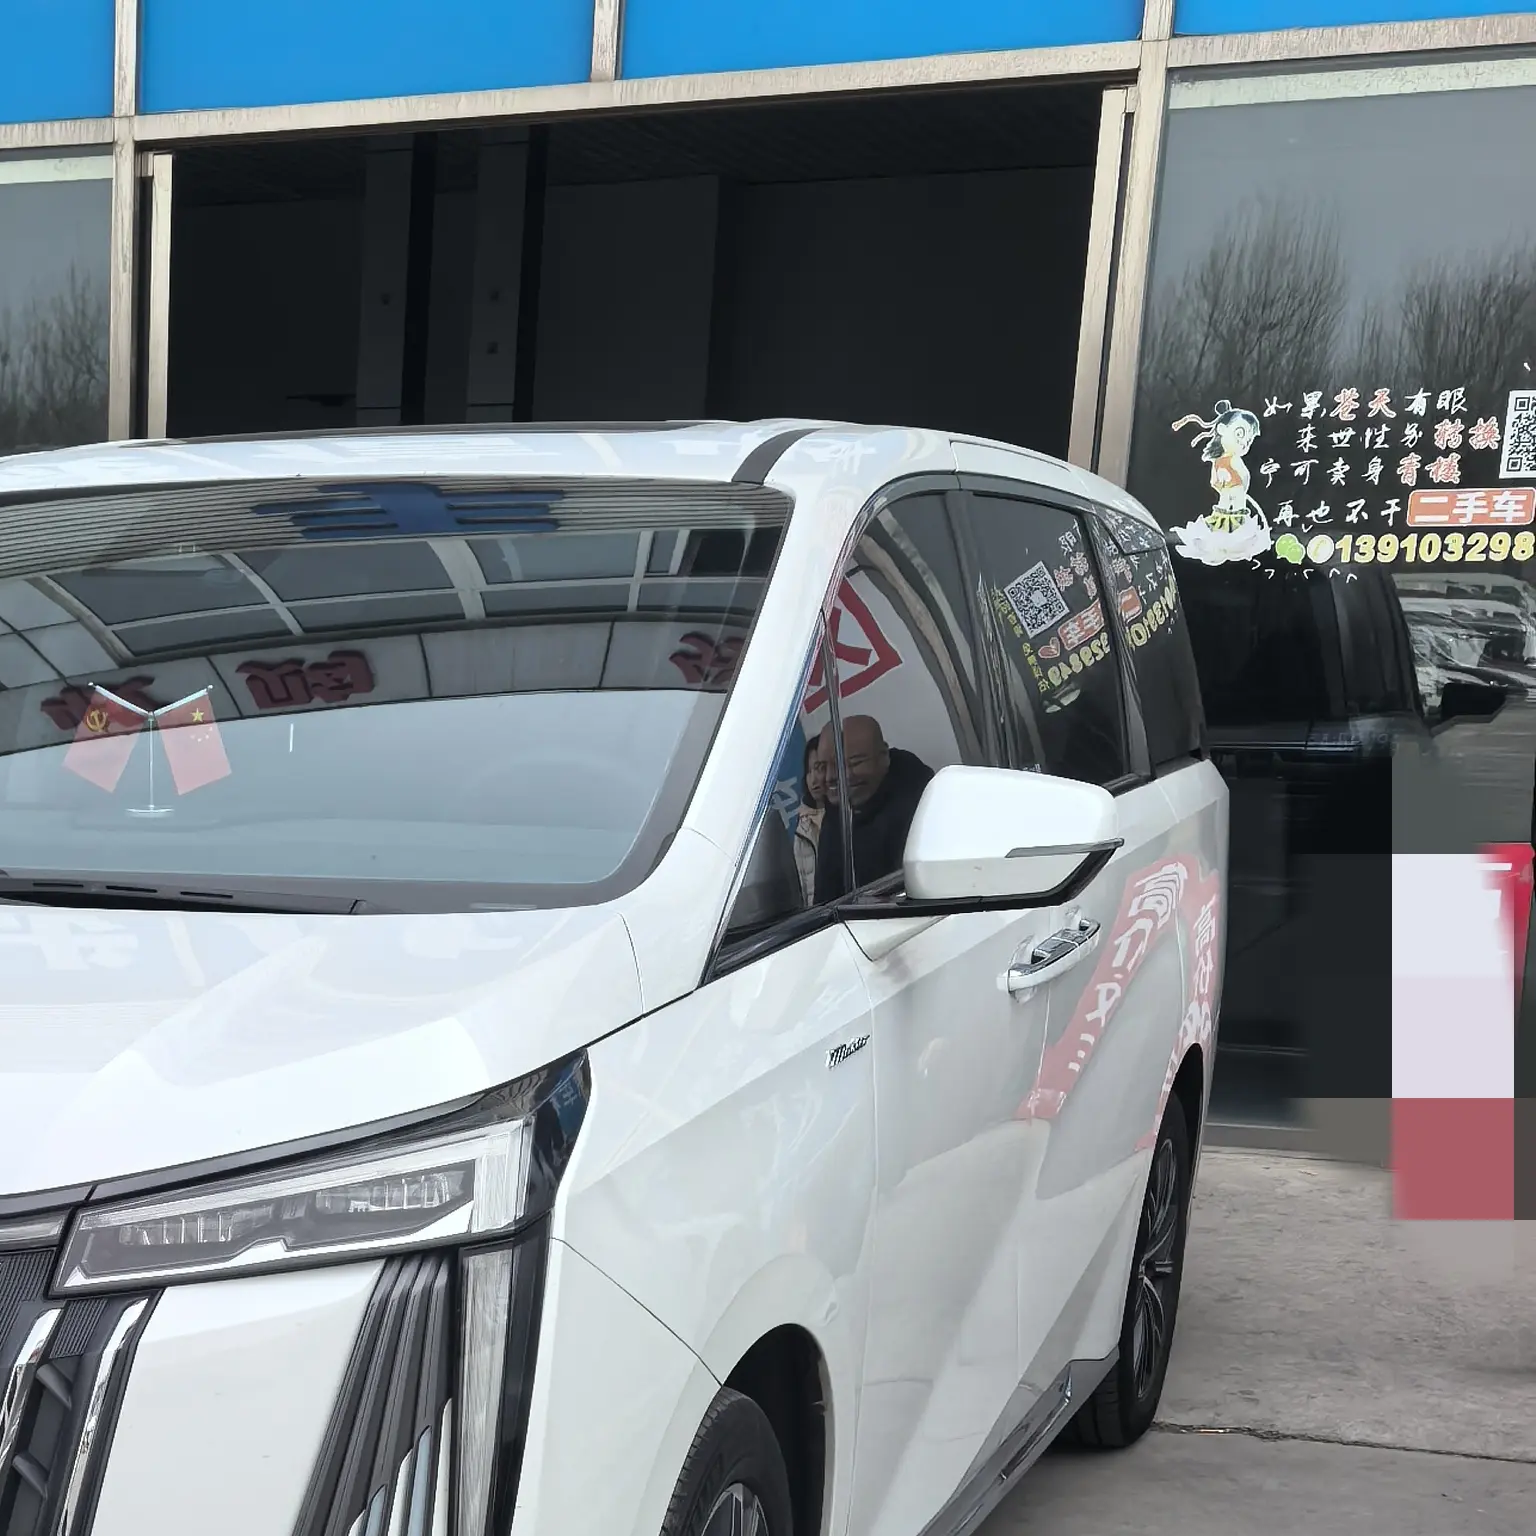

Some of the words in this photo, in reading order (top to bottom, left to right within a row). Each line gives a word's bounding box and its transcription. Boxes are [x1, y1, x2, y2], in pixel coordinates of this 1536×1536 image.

[1259, 452, 1462, 488] 宁可卖身青楼
[1335, 531, 1536, 563] 139103298
